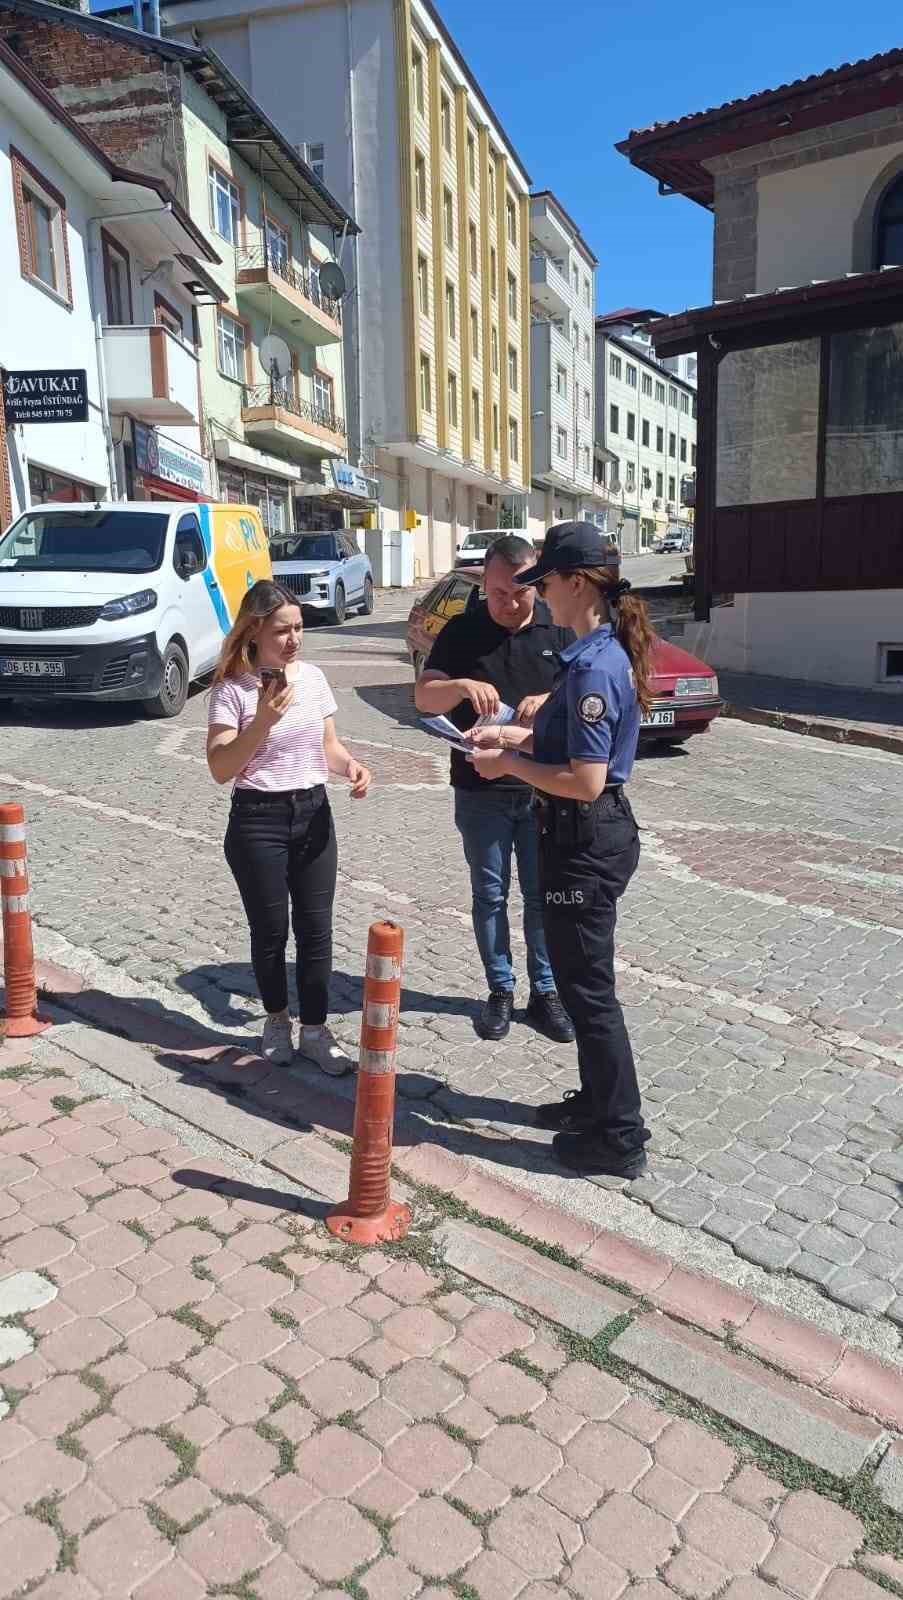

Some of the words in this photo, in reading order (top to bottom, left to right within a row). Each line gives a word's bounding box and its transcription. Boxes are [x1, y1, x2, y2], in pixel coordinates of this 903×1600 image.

[20, 376, 79, 392] AVUKAT
[43, 394, 83, 405] ÜSTÜNDAĞ
[64, 409, 73, 417] 75
[7, 662, 19, 672] 06
[23, 662, 41, 673] EFA
[43, 662, 61, 673] 395
[658, 711, 673, 723] 161
